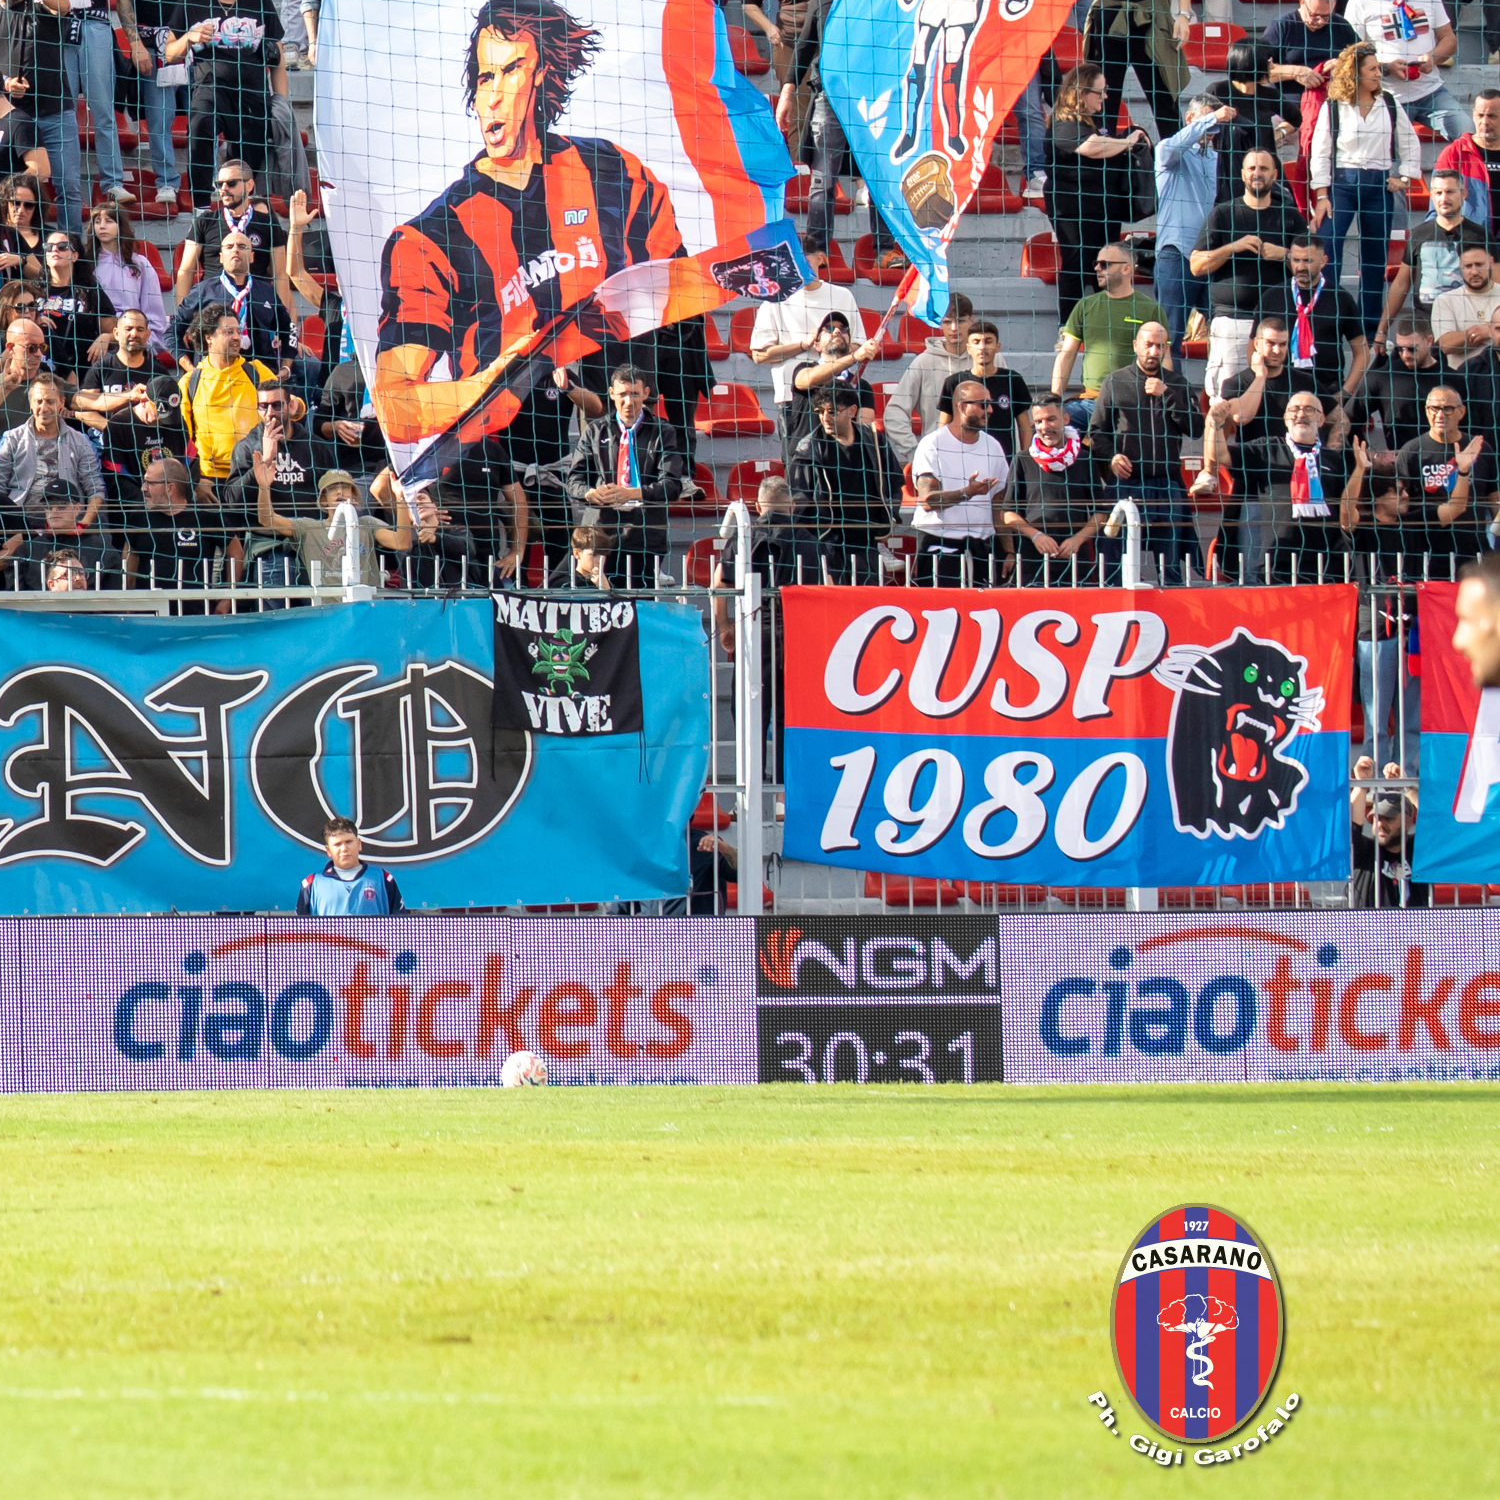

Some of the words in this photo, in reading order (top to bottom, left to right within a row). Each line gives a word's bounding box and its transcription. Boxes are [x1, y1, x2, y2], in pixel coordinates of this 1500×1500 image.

[1422, 464, 1454, 476] CUSP
[1423, 475, 1450, 488] 1980
[496, 592, 634, 633] MATTEO
[824, 604, 1170, 721] CUSP
[523, 692, 612, 735] VIVE
[820, 745, 1148, 861] 1980
[793, 936, 996, 992] NGM
[114, 949, 697, 1063] ciaotickets
[775, 1031, 975, 1084] 30:31
